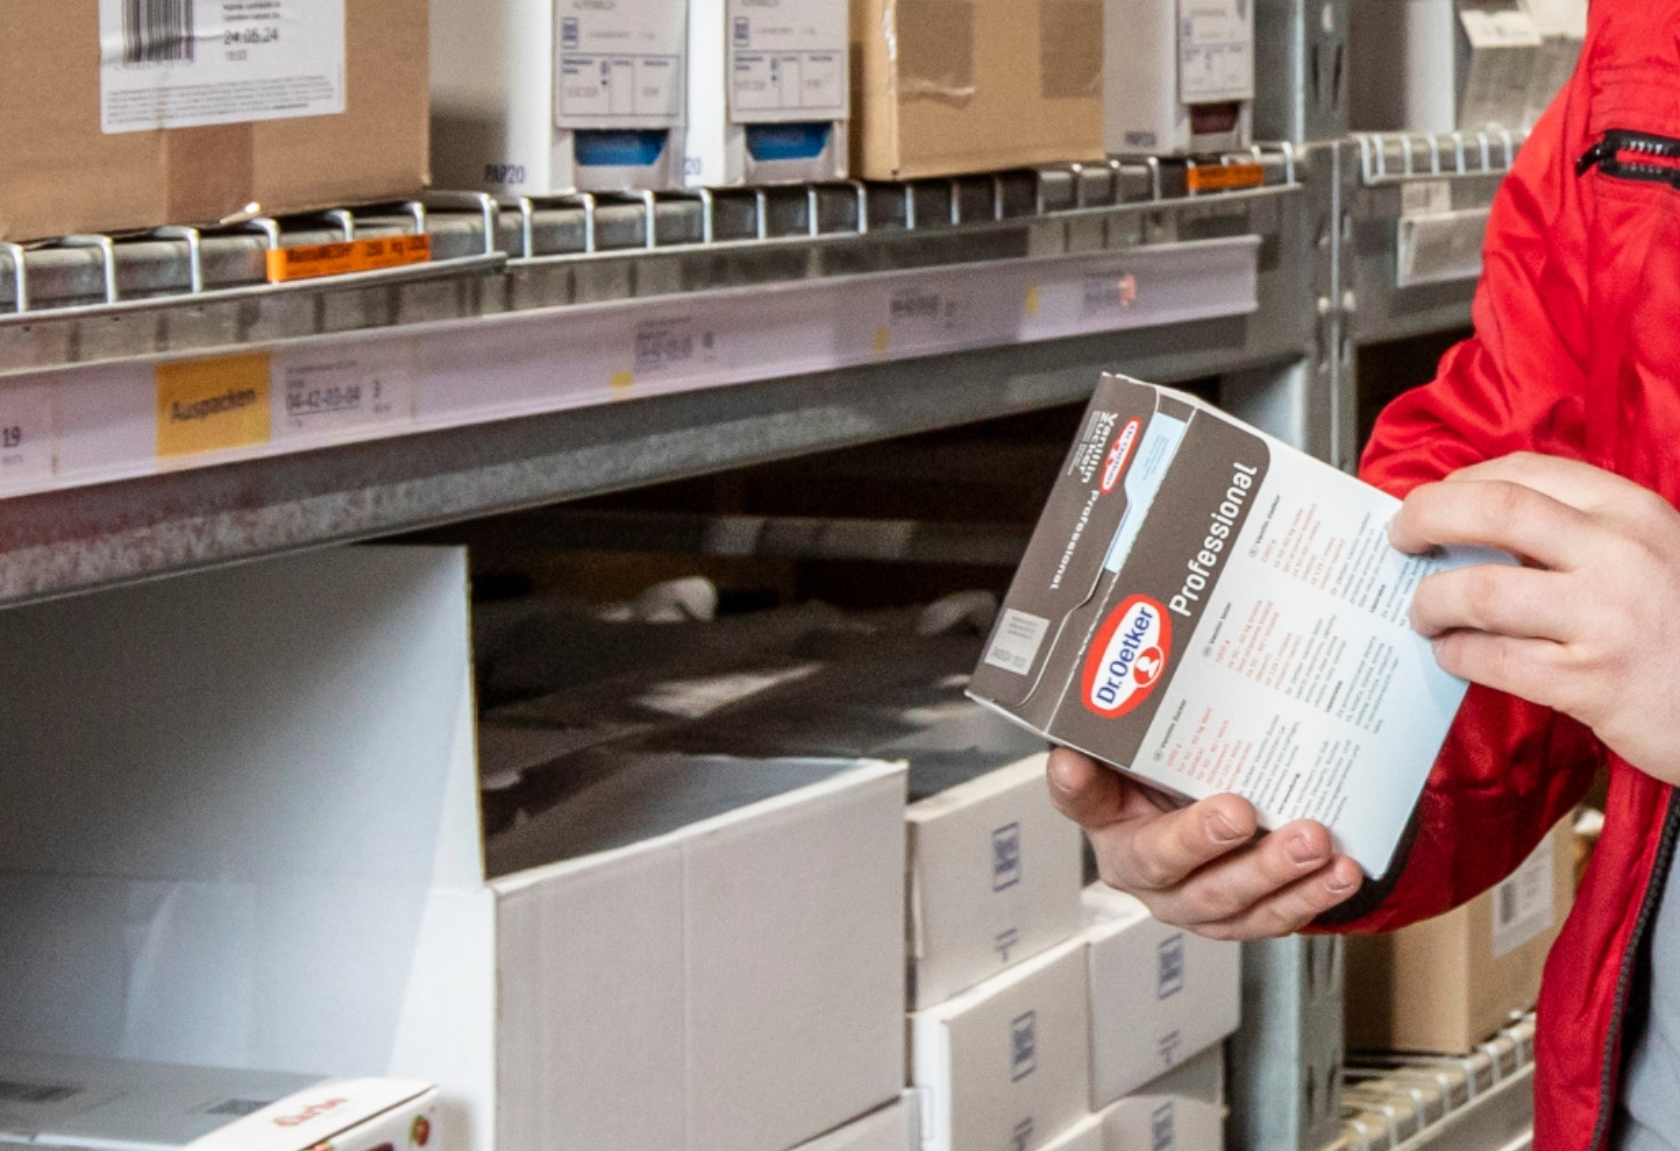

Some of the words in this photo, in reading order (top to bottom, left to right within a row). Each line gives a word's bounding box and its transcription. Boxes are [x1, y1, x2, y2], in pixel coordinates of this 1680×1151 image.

[2, 426, 22, 447] 19
[171, 388, 256, 423] Auspacken
[1048, 487, 1100, 592] Professional
[1167, 461, 1258, 617] Professional
